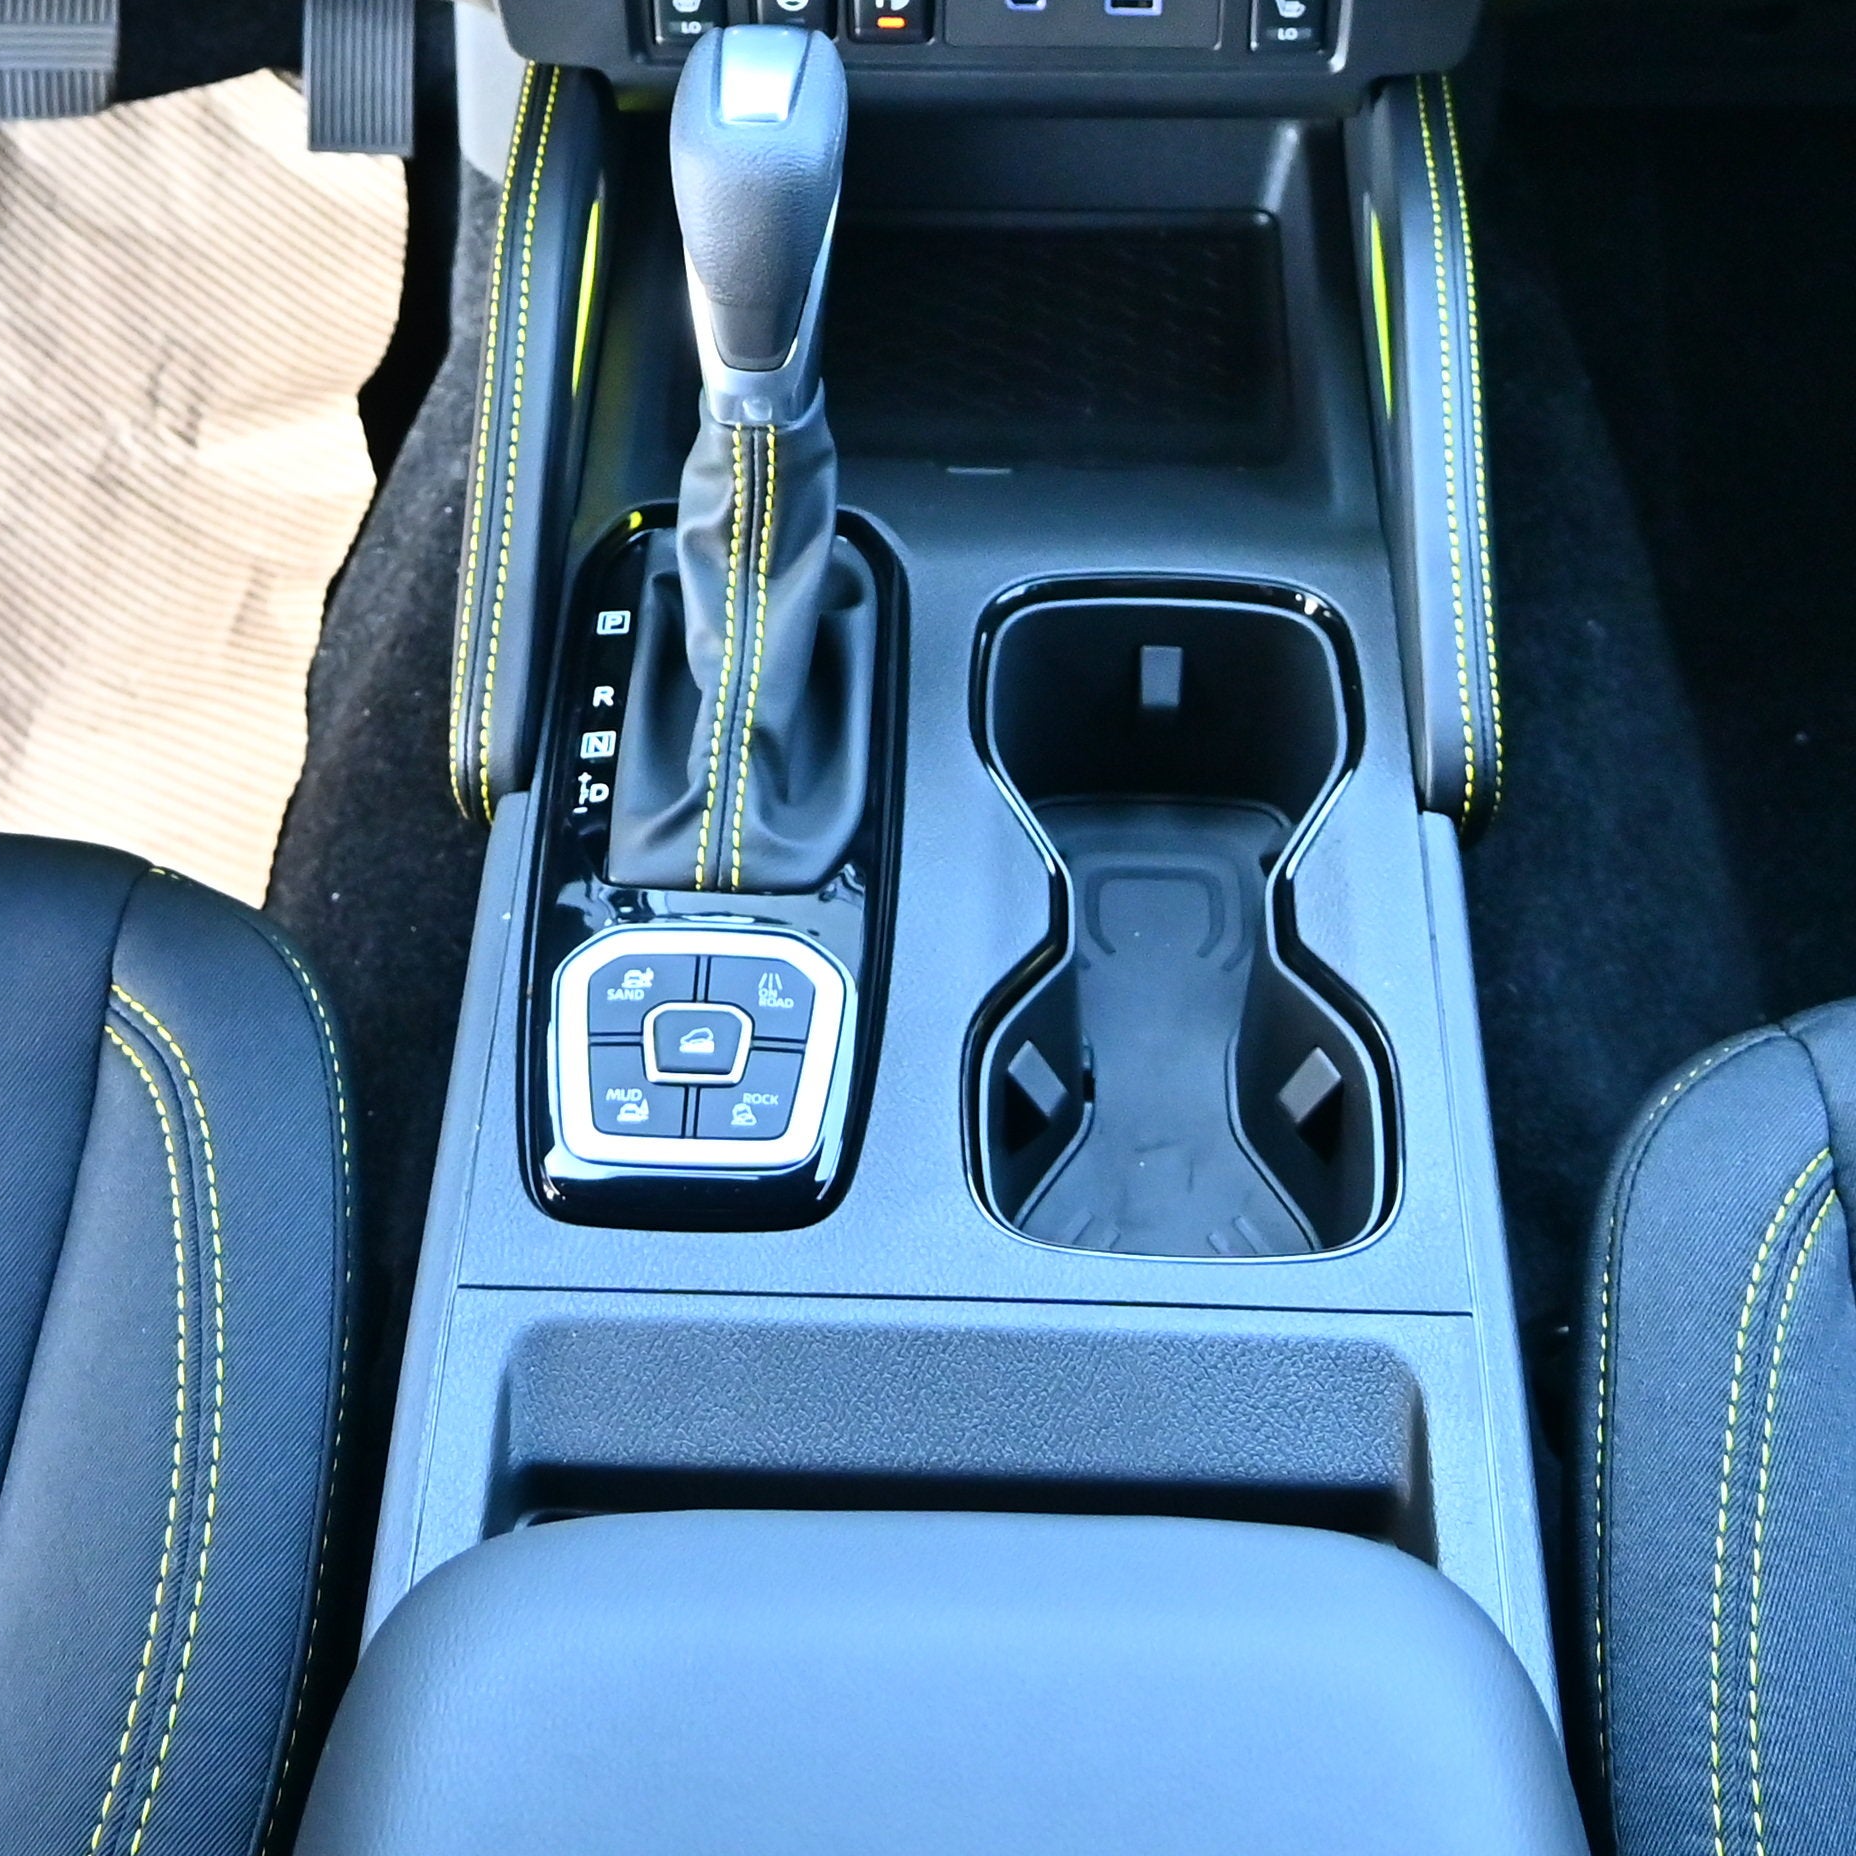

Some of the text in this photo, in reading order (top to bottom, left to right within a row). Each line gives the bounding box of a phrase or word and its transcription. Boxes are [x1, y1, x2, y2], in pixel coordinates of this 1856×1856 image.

[681, 21, 702, 34] LO
[1277, 28, 1298, 41] LO
[593, 686, 615, 707] R
[589, 782, 609, 802] D
[607, 988, 645, 1001] SAND
[758, 989, 778, 999] ON
[758, 997, 794, 1009] ROAD
[606, 1088, 642, 1101] MUD
[743, 1093, 779, 1105] ROCK
